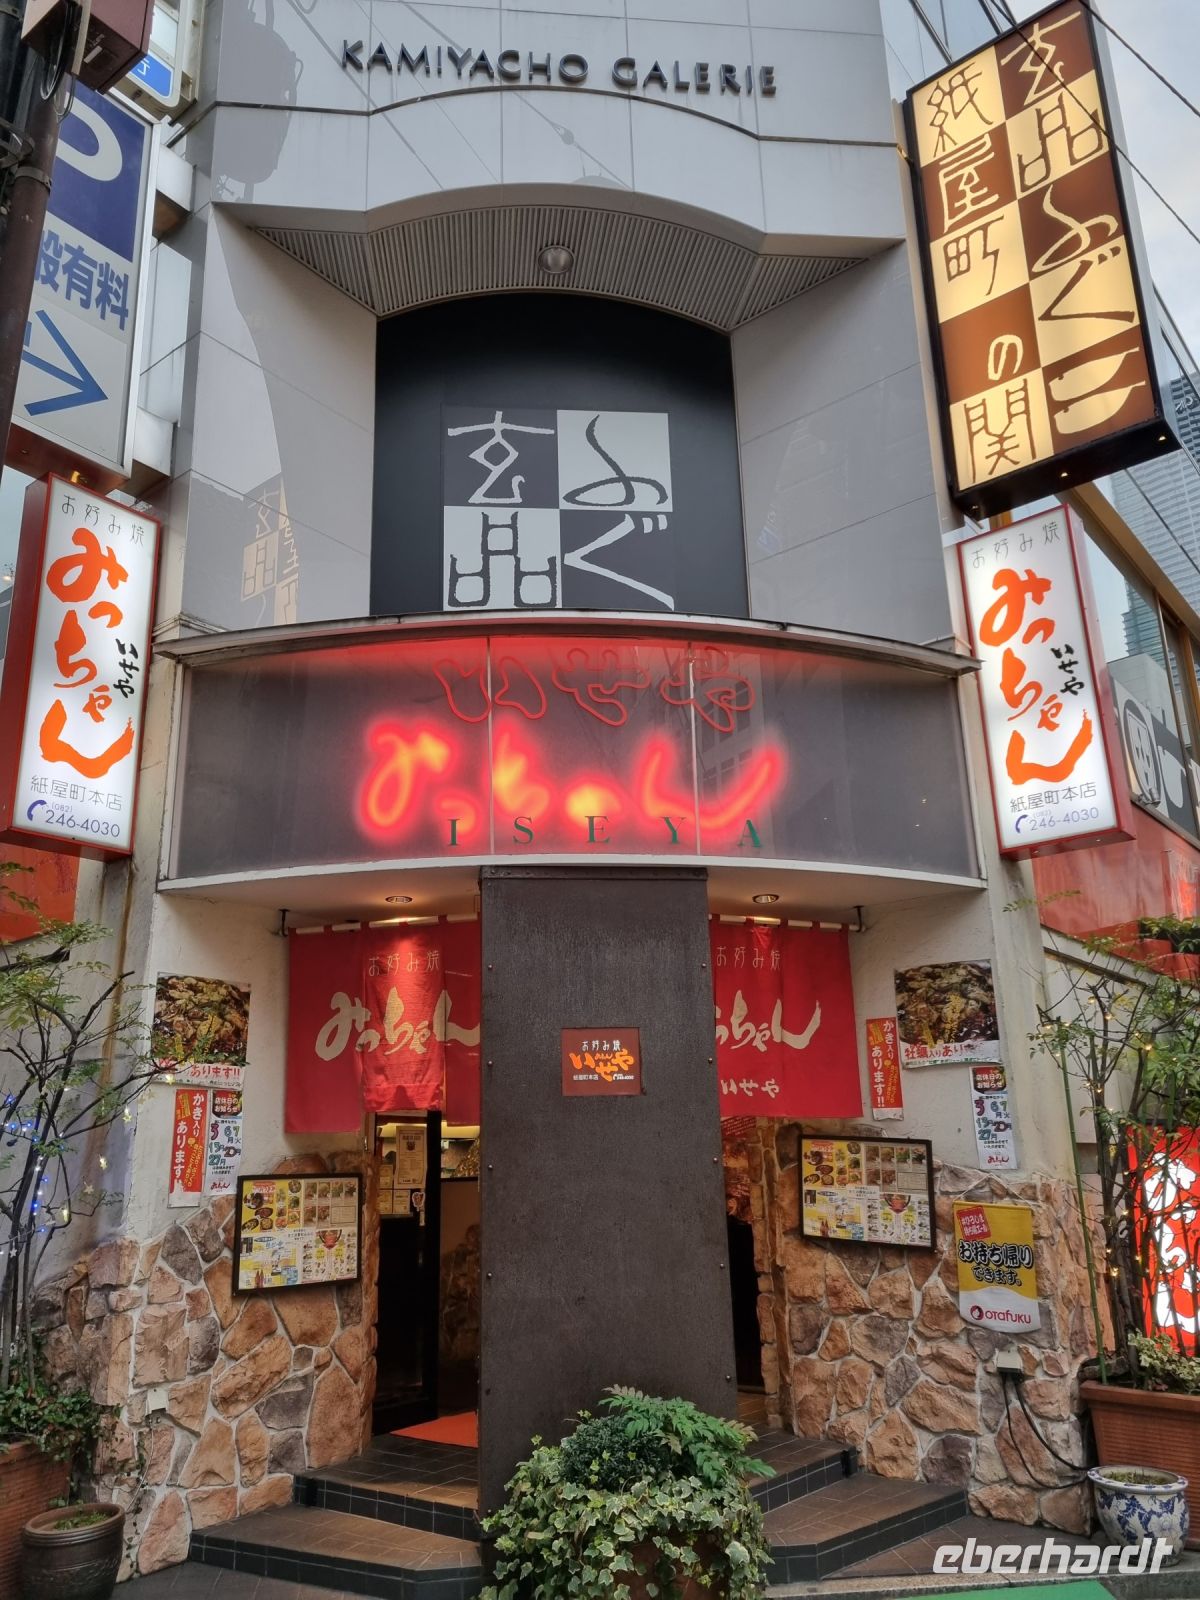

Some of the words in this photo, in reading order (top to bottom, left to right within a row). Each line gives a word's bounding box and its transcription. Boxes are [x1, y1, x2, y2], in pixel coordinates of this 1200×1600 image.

[342, 39, 589, 83] KAMIYACHO
[611, 56, 777, 96] GALERIE
[61, 494, 145, 547] お好み焼
[972, 521, 1061, 569] お好み焼
[39, 527, 135, 779] みっちゃん
[113, 638, 140, 699] いせや
[1050, 643, 1085, 696] いせや
[979, 568, 1093, 786] みっちゃん
[30, 774, 123, 812] 紙屋町本店
[1009, 781, 1097, 813] 紙屋町本店
[45, 808, 121, 838] 246-4030
[447, 815, 762, 848] ISEYA
[1028, 806, 1100, 832] 246-4030
[368, 950, 440, 977] お好み焼
[716, 945, 781, 971] お好み焼
[715, 990, 822, 1052] っちゃん
[883, 1020, 895, 1060] かき入り
[581, 1039, 621, 1051] お好み焼
[720, 1078, 780, 1099] いせや
[192, 1093, 205, 1138] かき入り
[958, 1240, 1034, 1269] お持ち帰り
[972, 1265, 1022, 1287] できます。
